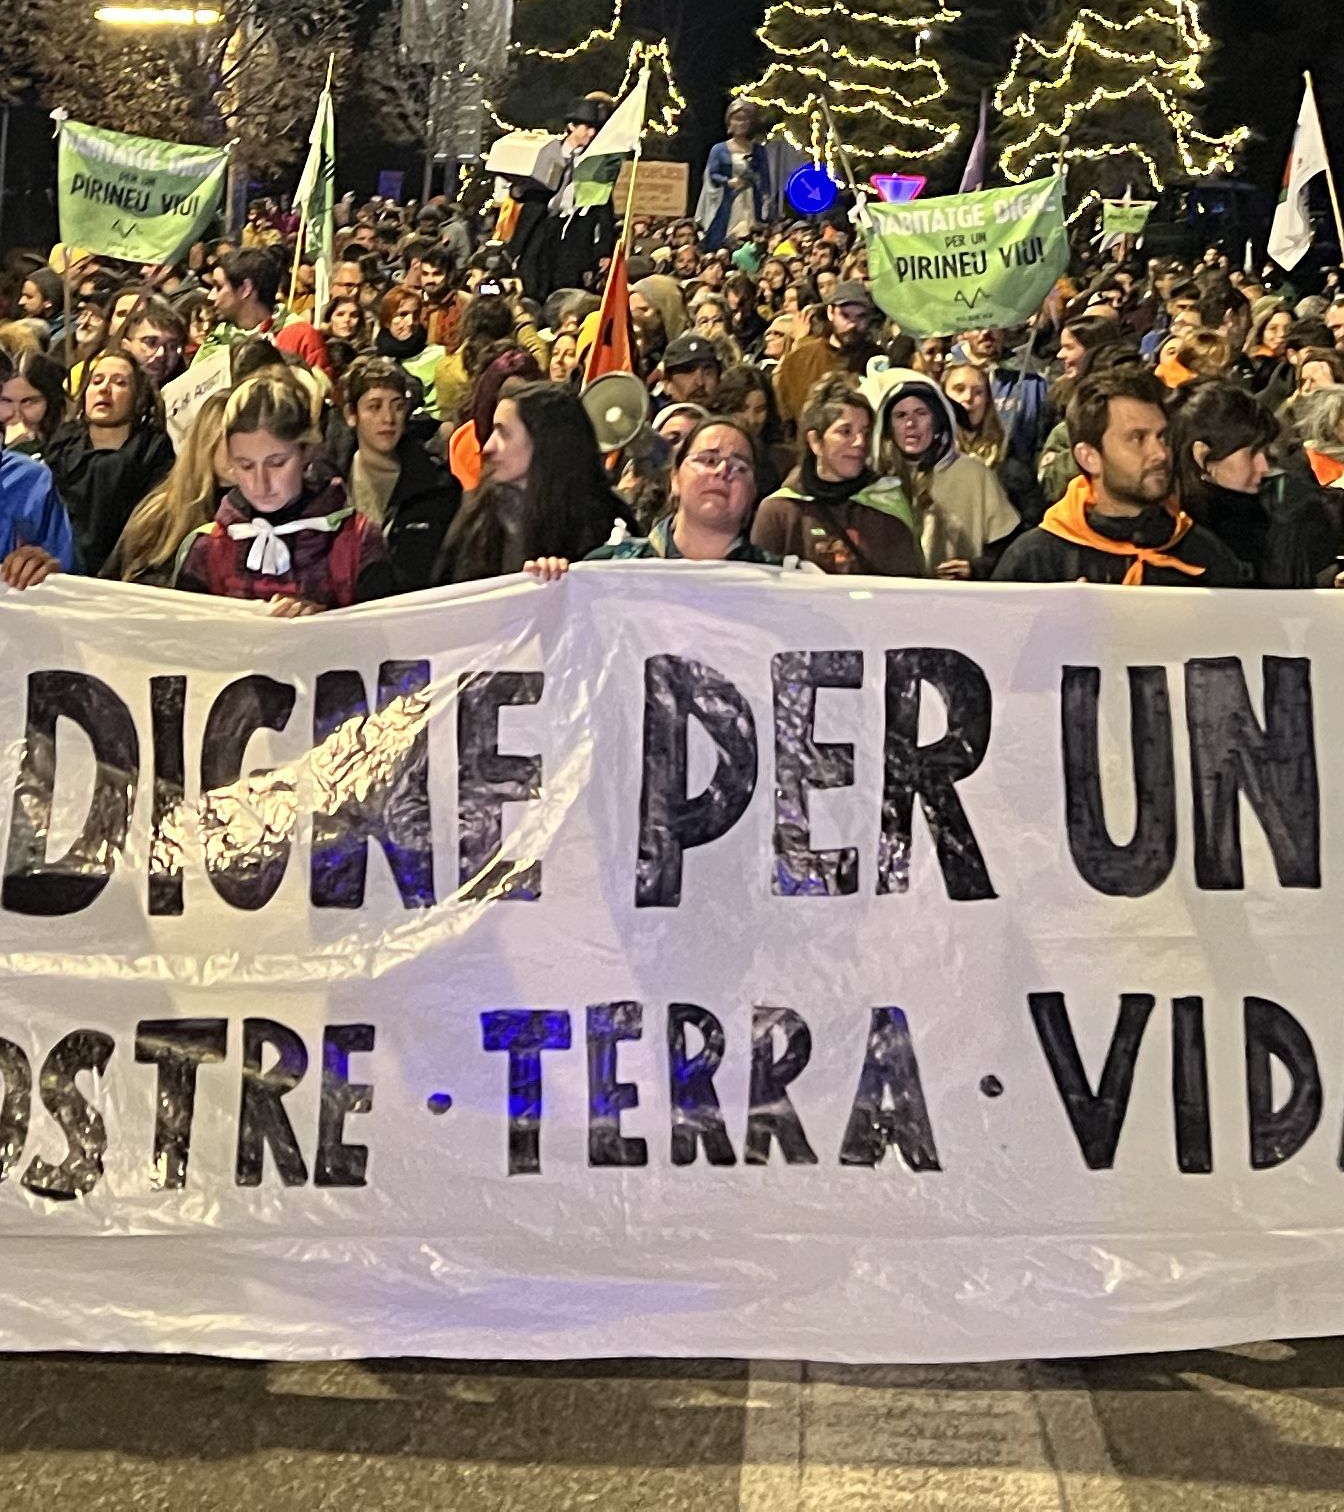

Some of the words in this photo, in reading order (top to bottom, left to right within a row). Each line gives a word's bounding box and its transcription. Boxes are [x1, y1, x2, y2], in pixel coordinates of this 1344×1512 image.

[70, 173, 151, 213] PIRINEU
[896, 250, 988, 283] PIRINEU
[999, 236, 1045, 269] VIU!
[945, 234, 966, 249] PER
[0, 659, 545, 917] DIGNE
[634, 647, 999, 909] PER
[1060, 654, 1323, 898] UN
[479, 1000, 943, 1177] TERRA
